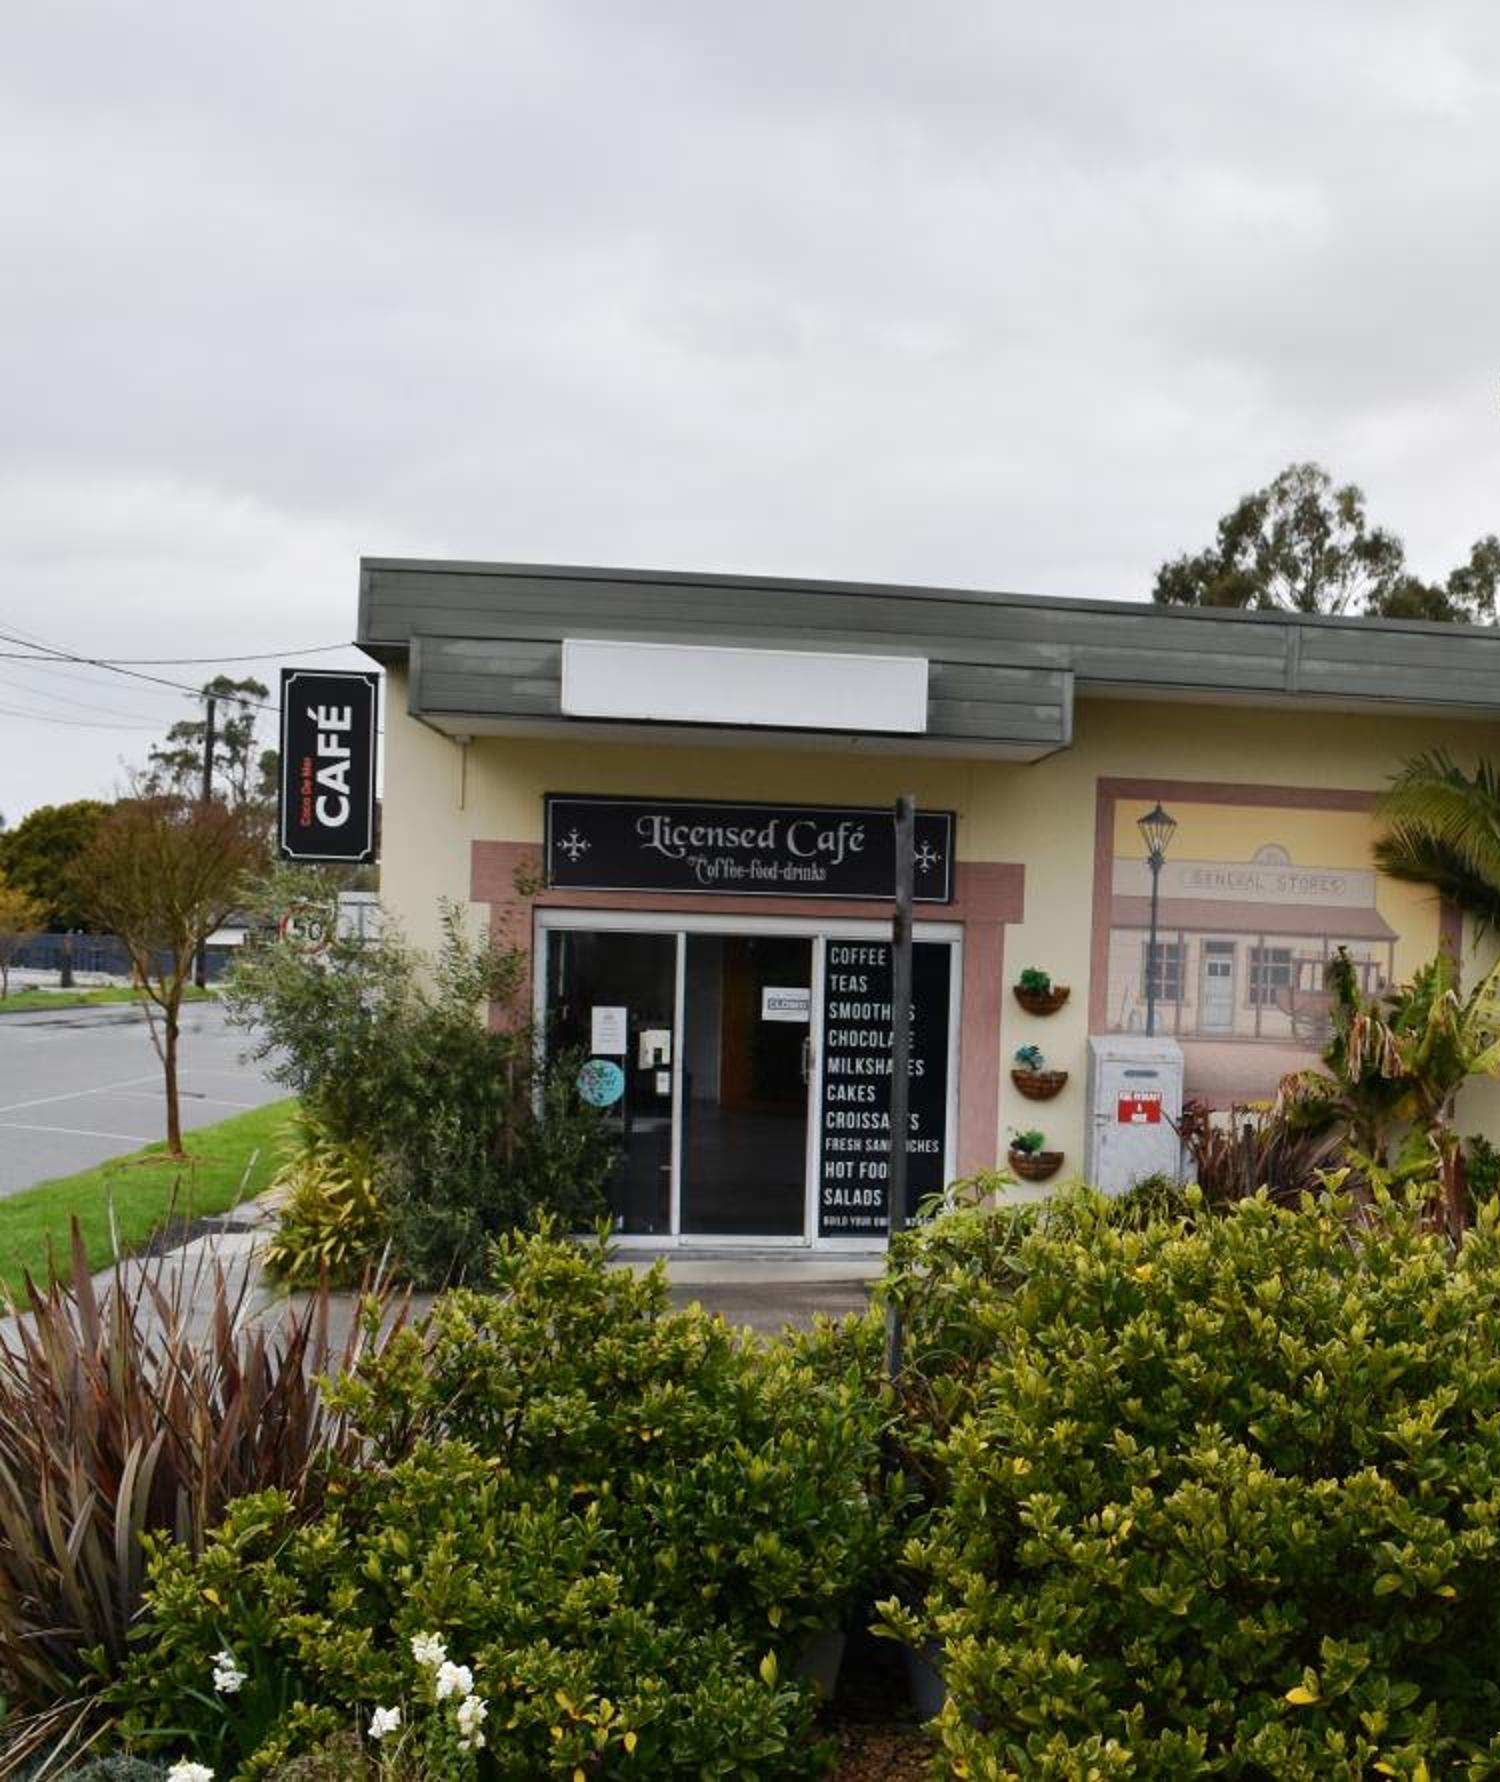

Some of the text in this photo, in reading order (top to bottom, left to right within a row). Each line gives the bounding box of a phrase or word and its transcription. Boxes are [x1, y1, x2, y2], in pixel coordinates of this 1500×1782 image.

[307, 704, 352, 828] CAFÉ
[636, 815, 865, 865] Licensed Café
[830, 947, 887, 966] COFFEE
[829, 974, 868, 993] TEAS
[828, 1003, 916, 1021] SMOOTHS
[827, 1029, 916, 1049] CHOCOLAE
[826, 1057, 926, 1077] MILKSHAES
[826, 1085, 876, 1102] CAKES
[825, 1111, 920, 1130] CROISSAS
[825, 1138, 940, 1153] FRESH SANICHES
[824, 1161, 890, 1180] HOT FOO
[823, 1189, 882, 1207] SALADS
[850, 1216, 873, 1227] YOUR
